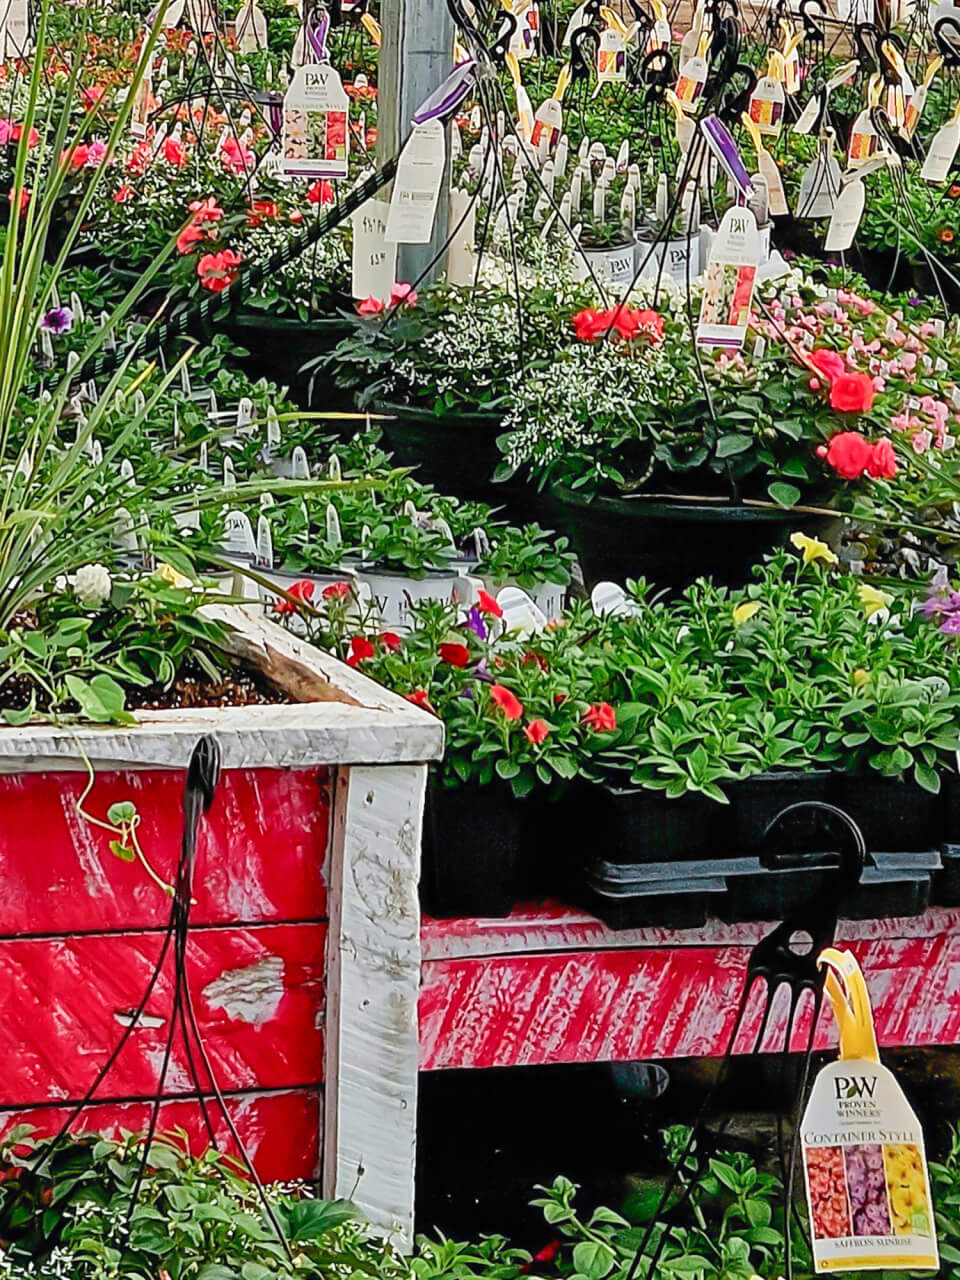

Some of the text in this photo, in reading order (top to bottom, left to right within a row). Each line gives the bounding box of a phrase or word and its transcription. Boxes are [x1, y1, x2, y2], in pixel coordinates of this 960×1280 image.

[305, 73, 329, 86] PW
[729, 218, 749, 233] PW
[834, 1076, 878, 1100] PW
[838, 1100, 877, 1109] PROVEN
[836, 1108, 881, 1118] WINNERS
[803, 1129, 915, 1145] CONTAINER STYLE
